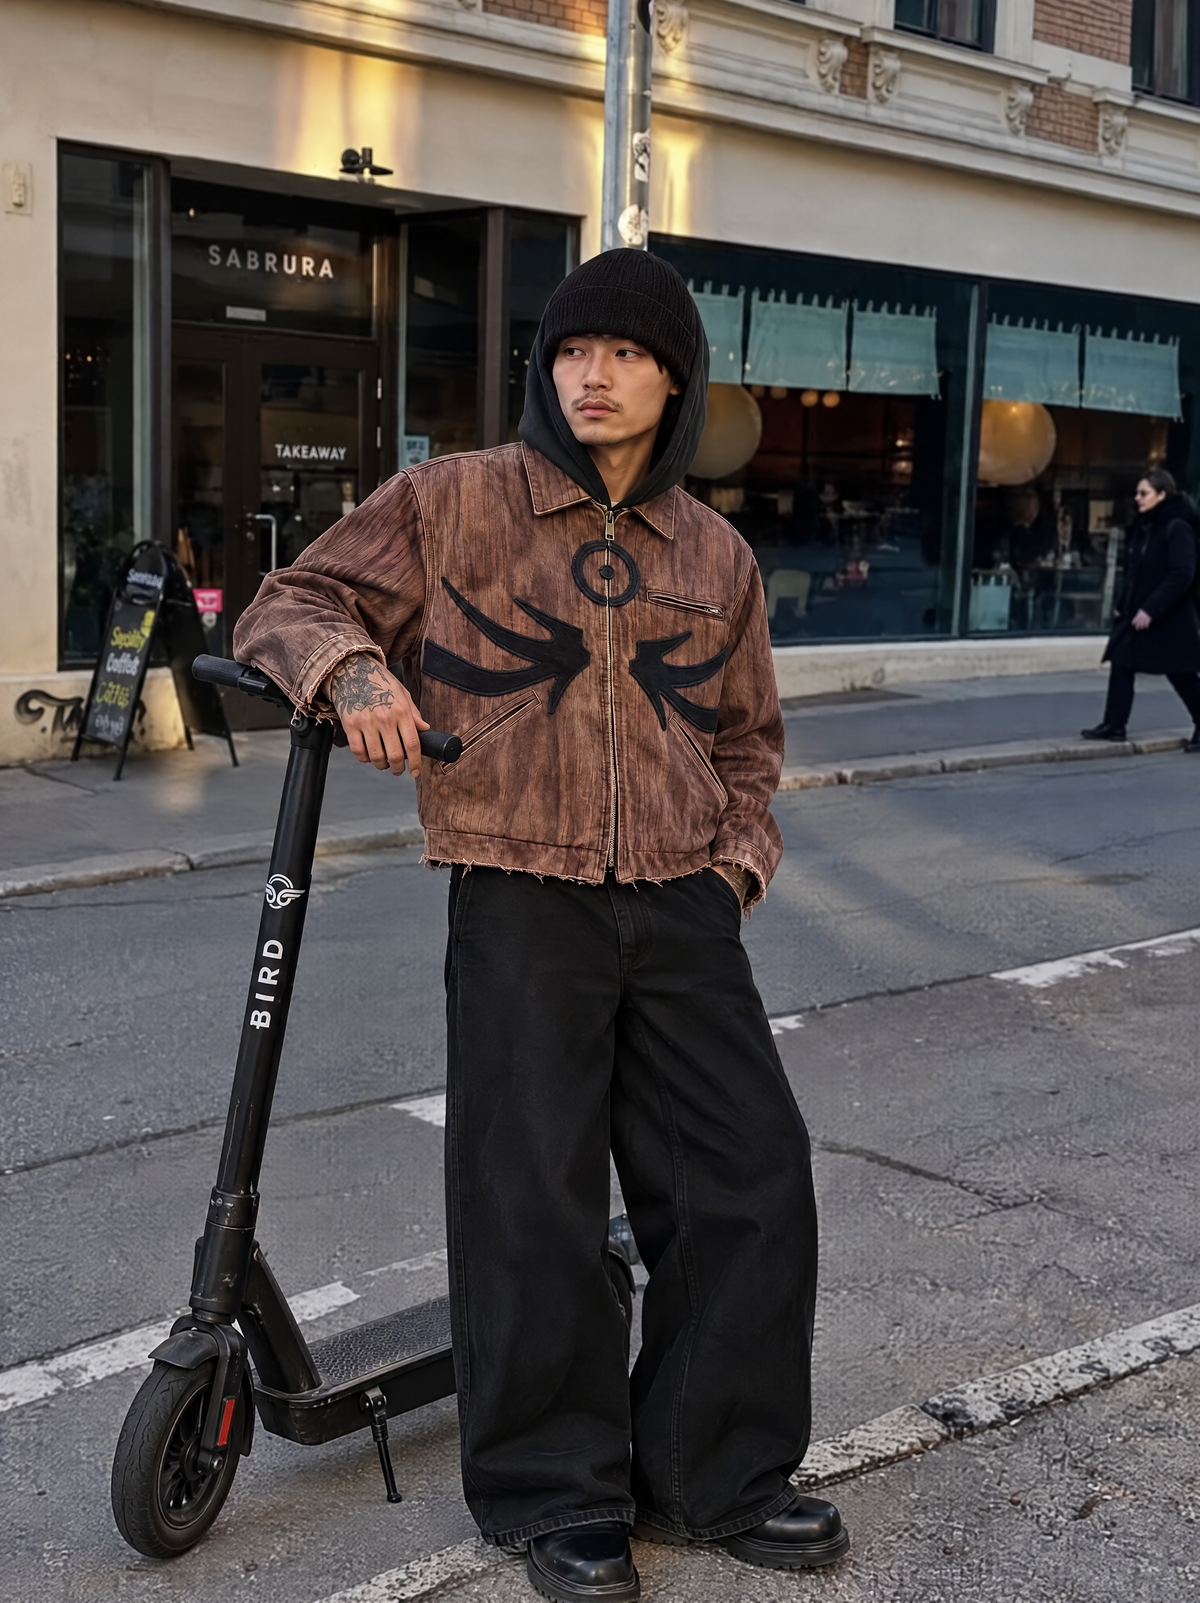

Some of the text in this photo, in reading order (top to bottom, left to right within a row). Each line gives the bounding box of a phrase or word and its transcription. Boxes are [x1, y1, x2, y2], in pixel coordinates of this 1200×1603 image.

[208, 244, 334, 279] SABRURA
[275, 443, 347, 461] TAKEAWAY
[250, 939, 284, 1030] BIRD
